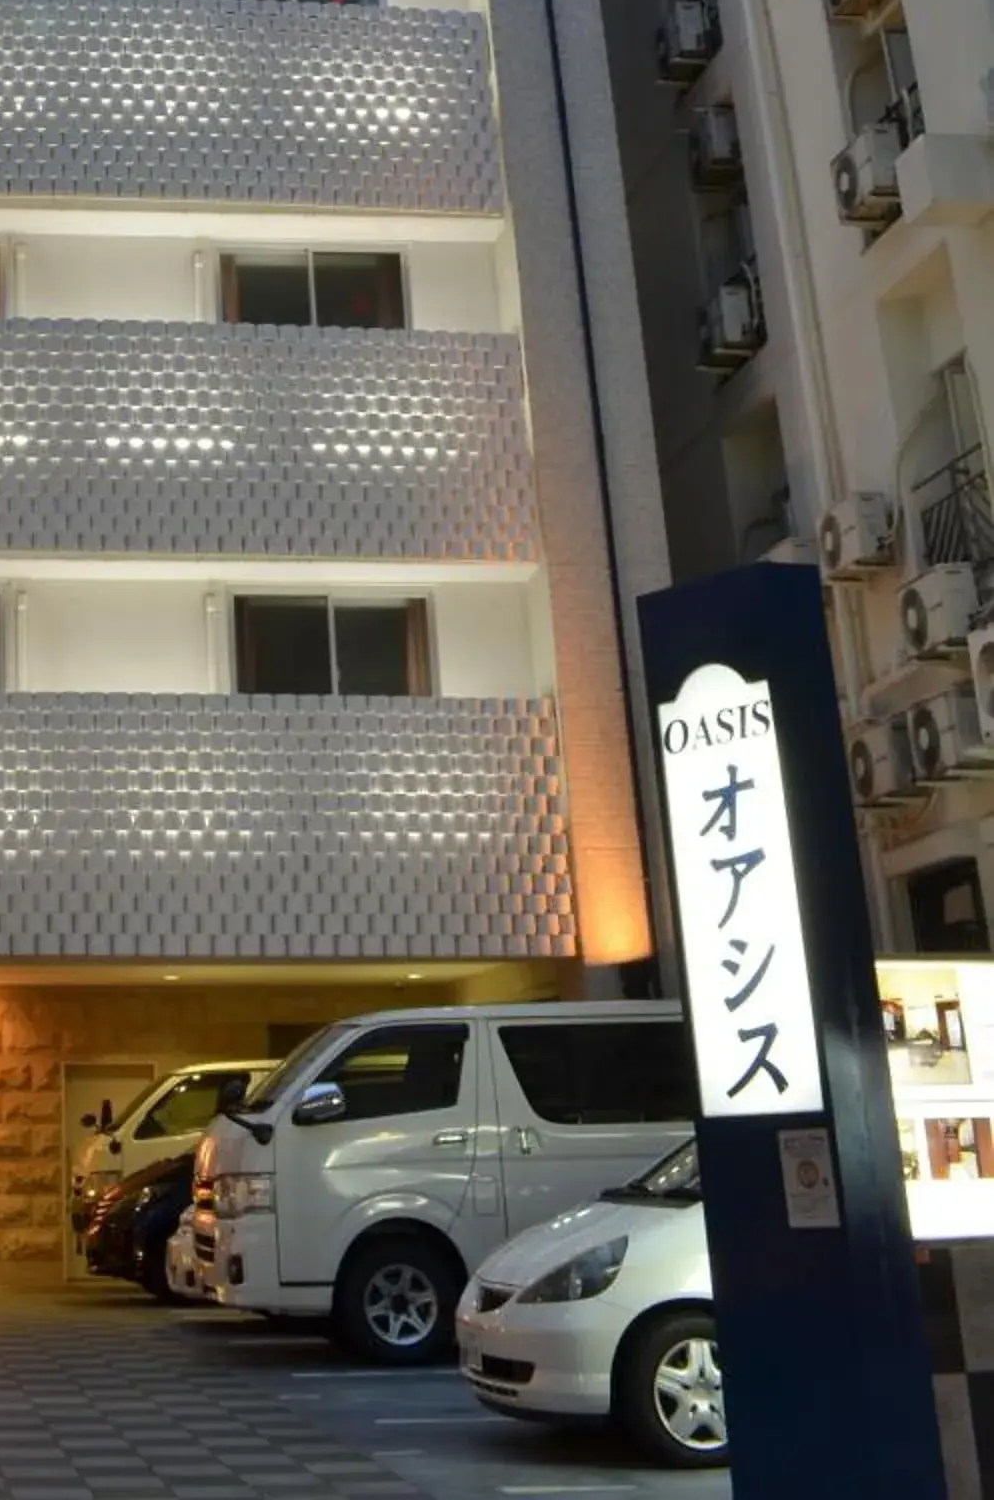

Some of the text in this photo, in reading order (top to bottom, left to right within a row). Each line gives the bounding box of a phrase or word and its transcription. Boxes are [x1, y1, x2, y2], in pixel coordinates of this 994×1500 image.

[663, 700, 772, 755] OASIS
[699, 764, 789, 1099] オアシス
